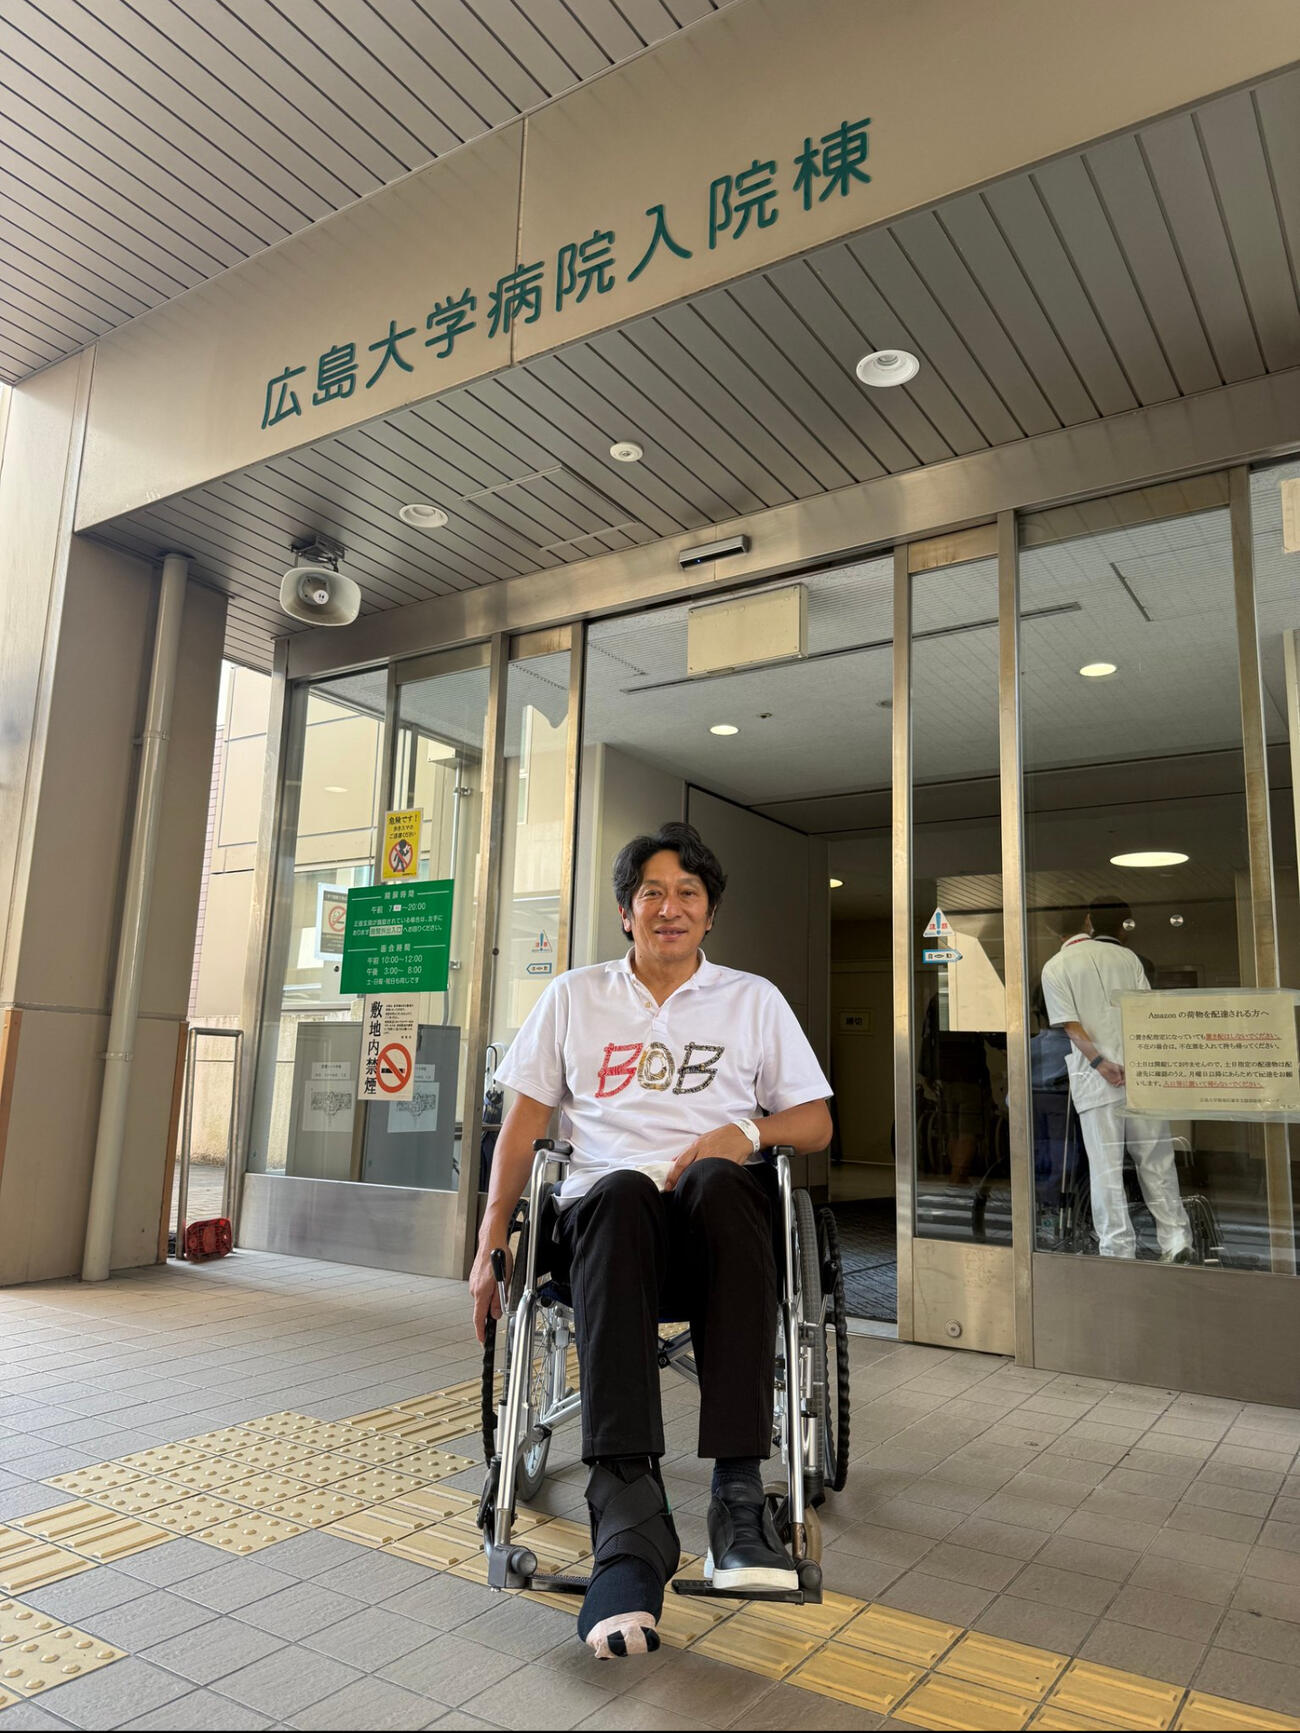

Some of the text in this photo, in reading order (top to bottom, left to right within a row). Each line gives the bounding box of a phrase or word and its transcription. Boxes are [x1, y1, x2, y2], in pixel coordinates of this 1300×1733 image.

[262, 118, 872, 429] 広島大学病院入院棟
[367, 956, 380, 965] 午前
[364, 1001, 384, 1095] 敷地内禁煙
[594, 1041, 725, 1098] BOB
